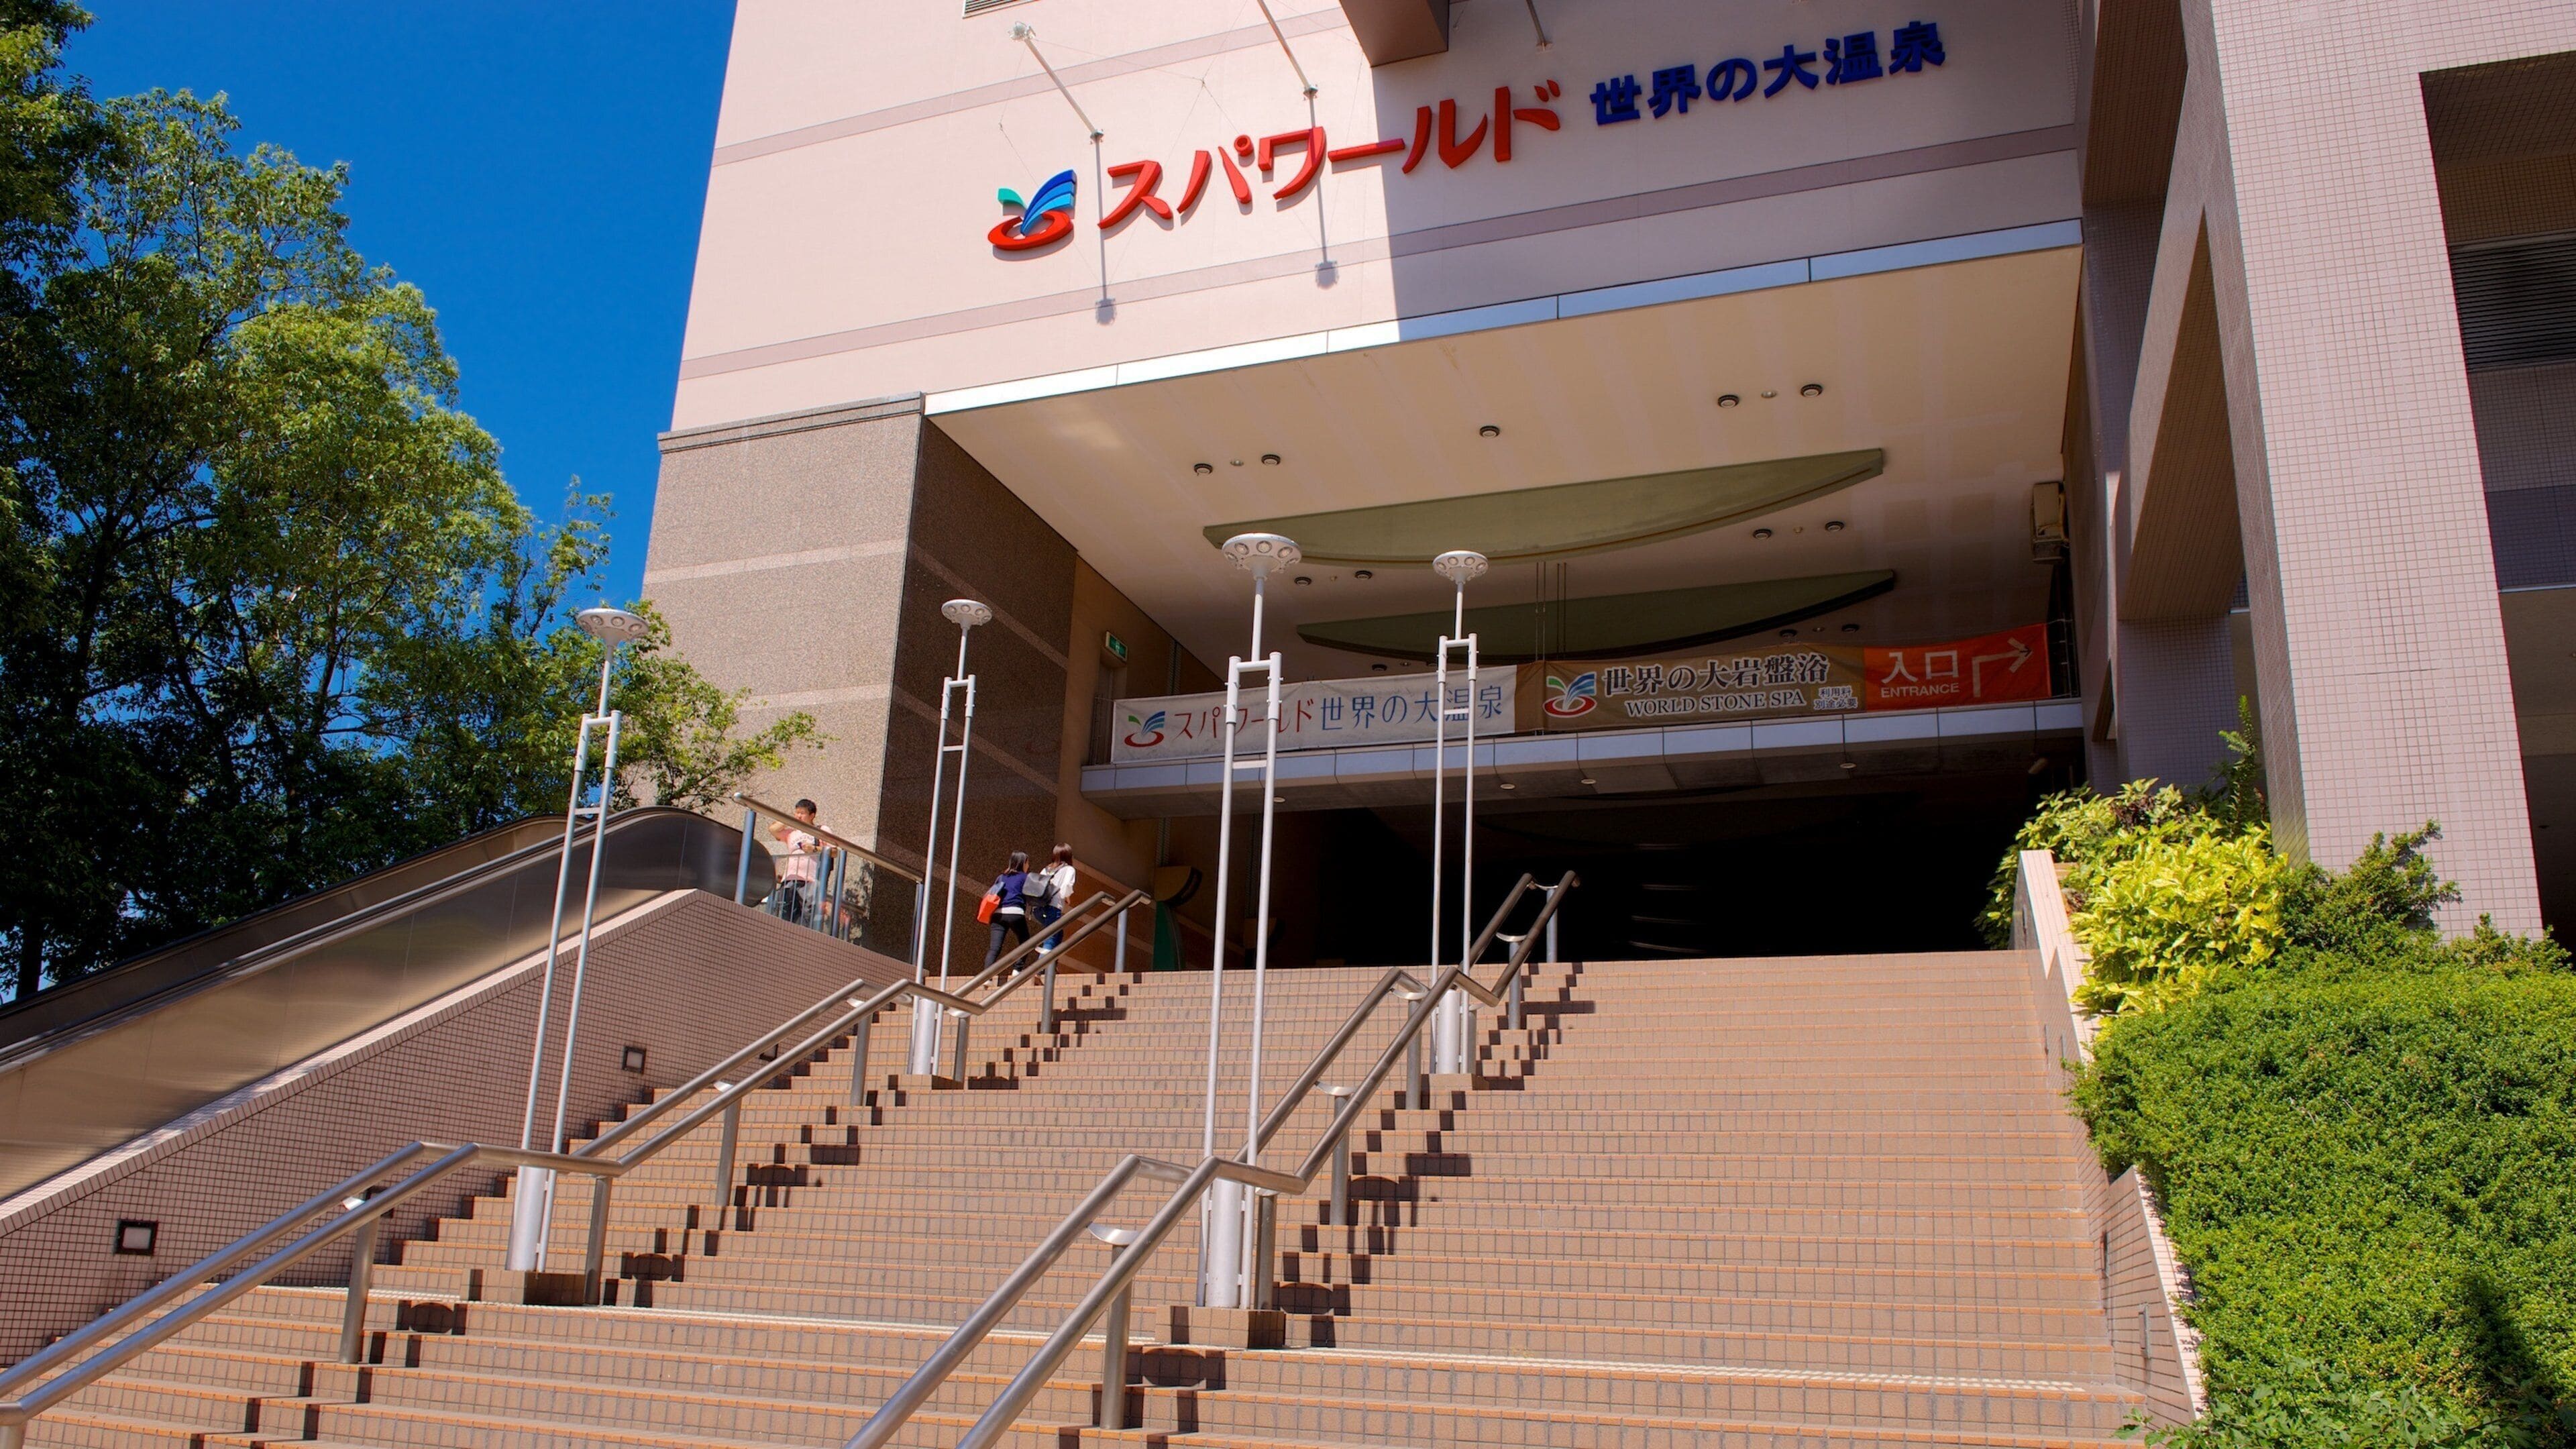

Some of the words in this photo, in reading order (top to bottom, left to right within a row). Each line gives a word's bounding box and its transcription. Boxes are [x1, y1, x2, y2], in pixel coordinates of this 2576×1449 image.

[1097, 79, 1560, 229] スパワールド
[1590, 21, 1945, 125] 世界の大温泉
[1603, 652, 1829, 697] 世界の大岩盤浴
[1881, 650, 1959, 684] 入口
[1626, 696, 1697, 717] WORLD
[1701, 693, 1766, 711] STONE
[1770, 689, 1807, 707] SPA
[1814, 698, 1858, 710] 別途必要
[1819, 686, 1852, 698] 利用料
[1881, 683, 1960, 698] ENTRANCE
[1321, 686, 1502, 730] 世界の大温泉
